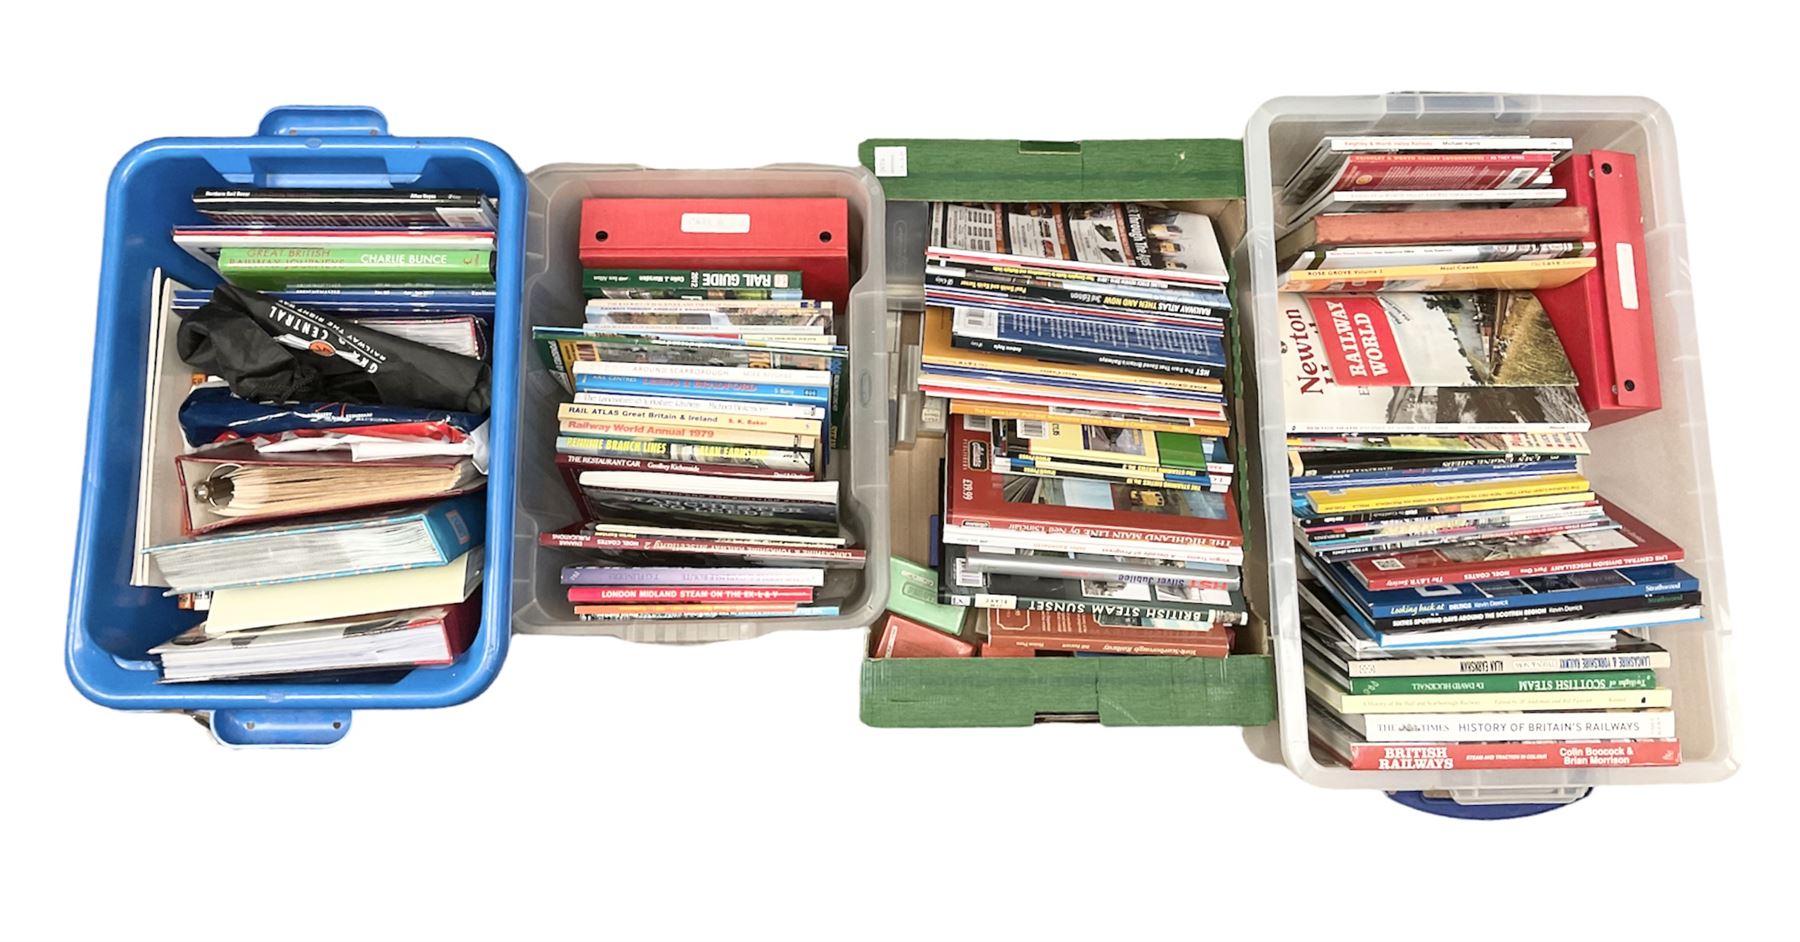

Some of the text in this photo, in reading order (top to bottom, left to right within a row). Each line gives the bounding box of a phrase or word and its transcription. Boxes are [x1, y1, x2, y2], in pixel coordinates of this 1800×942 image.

[246, 250, 329, 259] GREAT BRITISH
[360, 253, 448, 264] CHARLIE BUNCE
[690, 271, 771, 288] RAIL GUIDE 2012
[960, 280, 1027, 294] Paul Smith and Keith Turner
[1070, 292, 1212, 316] RAILWAY ATLAS THEN AND NOW 3rd Edition
[269, 306, 329, 341] CENTRAL
[297, 308, 387, 361] RAILWAY THE RIGHT
[1326, 300, 1368, 378] RAILWAY
[1358, 312, 1388, 377] WORLD
[1288, 308, 1324, 396] Newton
[1098, 357, 1122, 366] Railways
[1122, 359, 1142, 368] Britain's
[1143, 362, 1158, 370] Saved
[631, 366, 729, 376] AROUND SCARBOROUGH
[1170, 366, 1184, 374] Train
[1194, 368, 1210, 377] HST
[568, 406, 588, 414] RAIL
[592, 408, 619, 416] ATLAS
[622, 410, 645, 418] Great
[648, 411, 676, 420] Britain
[688, 414, 718, 423] Ireland
[568, 420, 715, 438] Railway World Annual 1979
[606, 439, 642, 453] BRANCH
[643, 442, 667, 454] LINES
[698, 445, 721, 456] ALAN
[568, 455, 641, 467] THE RESTAURANT CAR
[1476, 456, 1514, 466] ENGINE
[647, 462, 670, 471] Geoffrey
[1048, 526, 1232, 548] THE HIGHLAND MAIN LINE by Neil
[644, 541, 652, 550] 2
[653, 540, 708, 552] Miscellany
[1102, 548, 1132, 556] Progress
[1592, 559, 1622, 567] DIVISION
[1623, 556, 1654, 564] CENTRAL
[1654, 554, 1668, 562] LMS
[1534, 566, 1548, 574] Part
[1551, 562, 1592, 571] MISCELLANY
[1118, 574, 1154, 586] Jubilee
[1464, 572, 1490, 580] COATES
[1156, 578, 1184, 588] Silver
[1188, 580, 1228, 591] HST
[1386, 576, 1443, 587] The Society
[1645, 582, 1681, 592] Strathwood
[602, 590, 740, 598] LONDON MIDLAND STEAM ON THE
[1029, 601, 1202, 622] BRITISH STEAM SUNSET
[1390, 604, 1418, 616] Looking
[1419, 602, 1434, 613] back
[1434, 603, 1444, 611] at
[1490, 599, 1508, 608] Derrick
[1392, 604, 1583, 627] SIXTIES SPOTTING DAYS AROUND THE SCOTTISH REGION Kevin Derrick
[1102, 644, 1132, 652] Railway
[1490, 660, 1504, 672] ALAN
[1560, 656, 1651, 669] LANCASHIRE YORKSHIRE RAILWAY
[1412, 682, 1452, 690] HUCKNALL
[1452, 682, 1475, 690] DAVID
[1518, 678, 1646, 690] Twilight of SCOTTISH STEAM
[1377, 724, 1394, 732] THE
[1422, 724, 1450, 732] TIMES
[1458, 723, 1506, 732] HISTORY
[1510, 723, 1525, 732] OF
[1528, 723, 1582, 732] BRITAIN'S
[1586, 722, 1640, 732] RAILWAYS
[1384, 747, 1448, 758] BRITISH
[1560, 747, 1633, 757] Colin Boocock &
[1378, 758, 1454, 770] RAILWAYS
[1564, 756, 1629, 764] Brian Morrison
